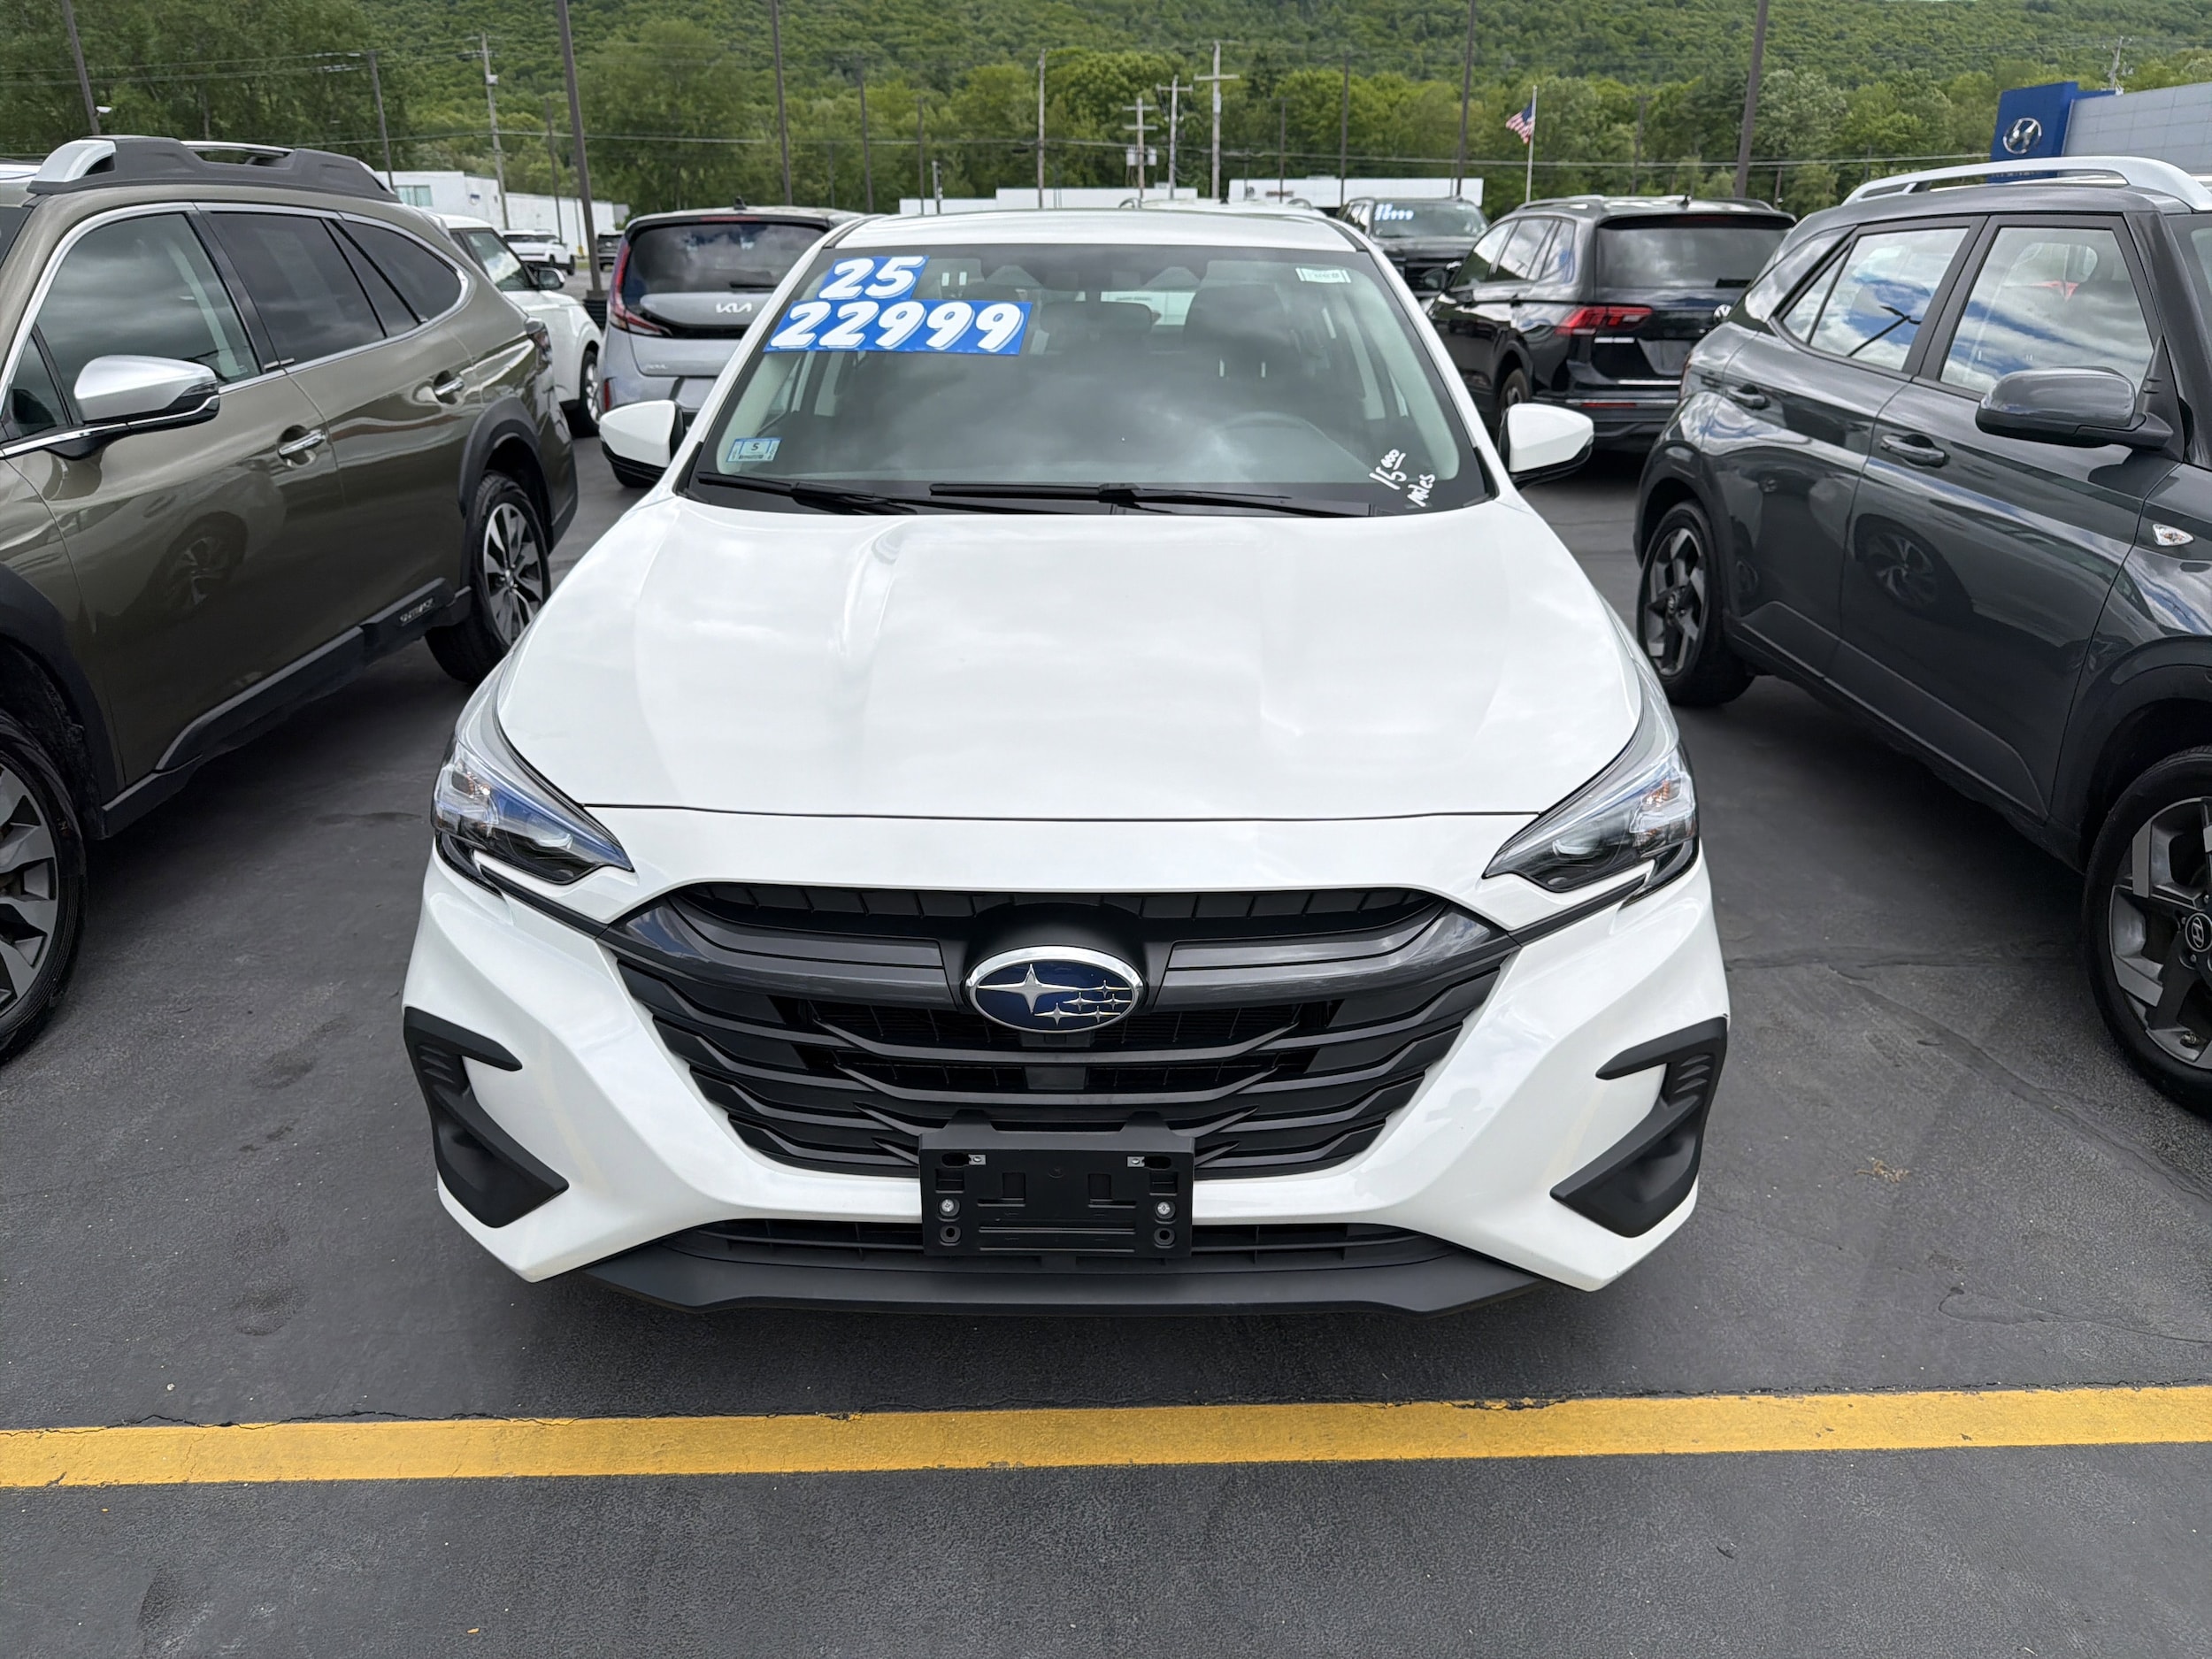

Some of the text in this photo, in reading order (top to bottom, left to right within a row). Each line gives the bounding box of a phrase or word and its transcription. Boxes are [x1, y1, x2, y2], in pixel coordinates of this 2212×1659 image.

[818, 256, 926, 300] 25
[715, 303, 752, 313] KIA
[770, 300, 1024, 351] 22999
